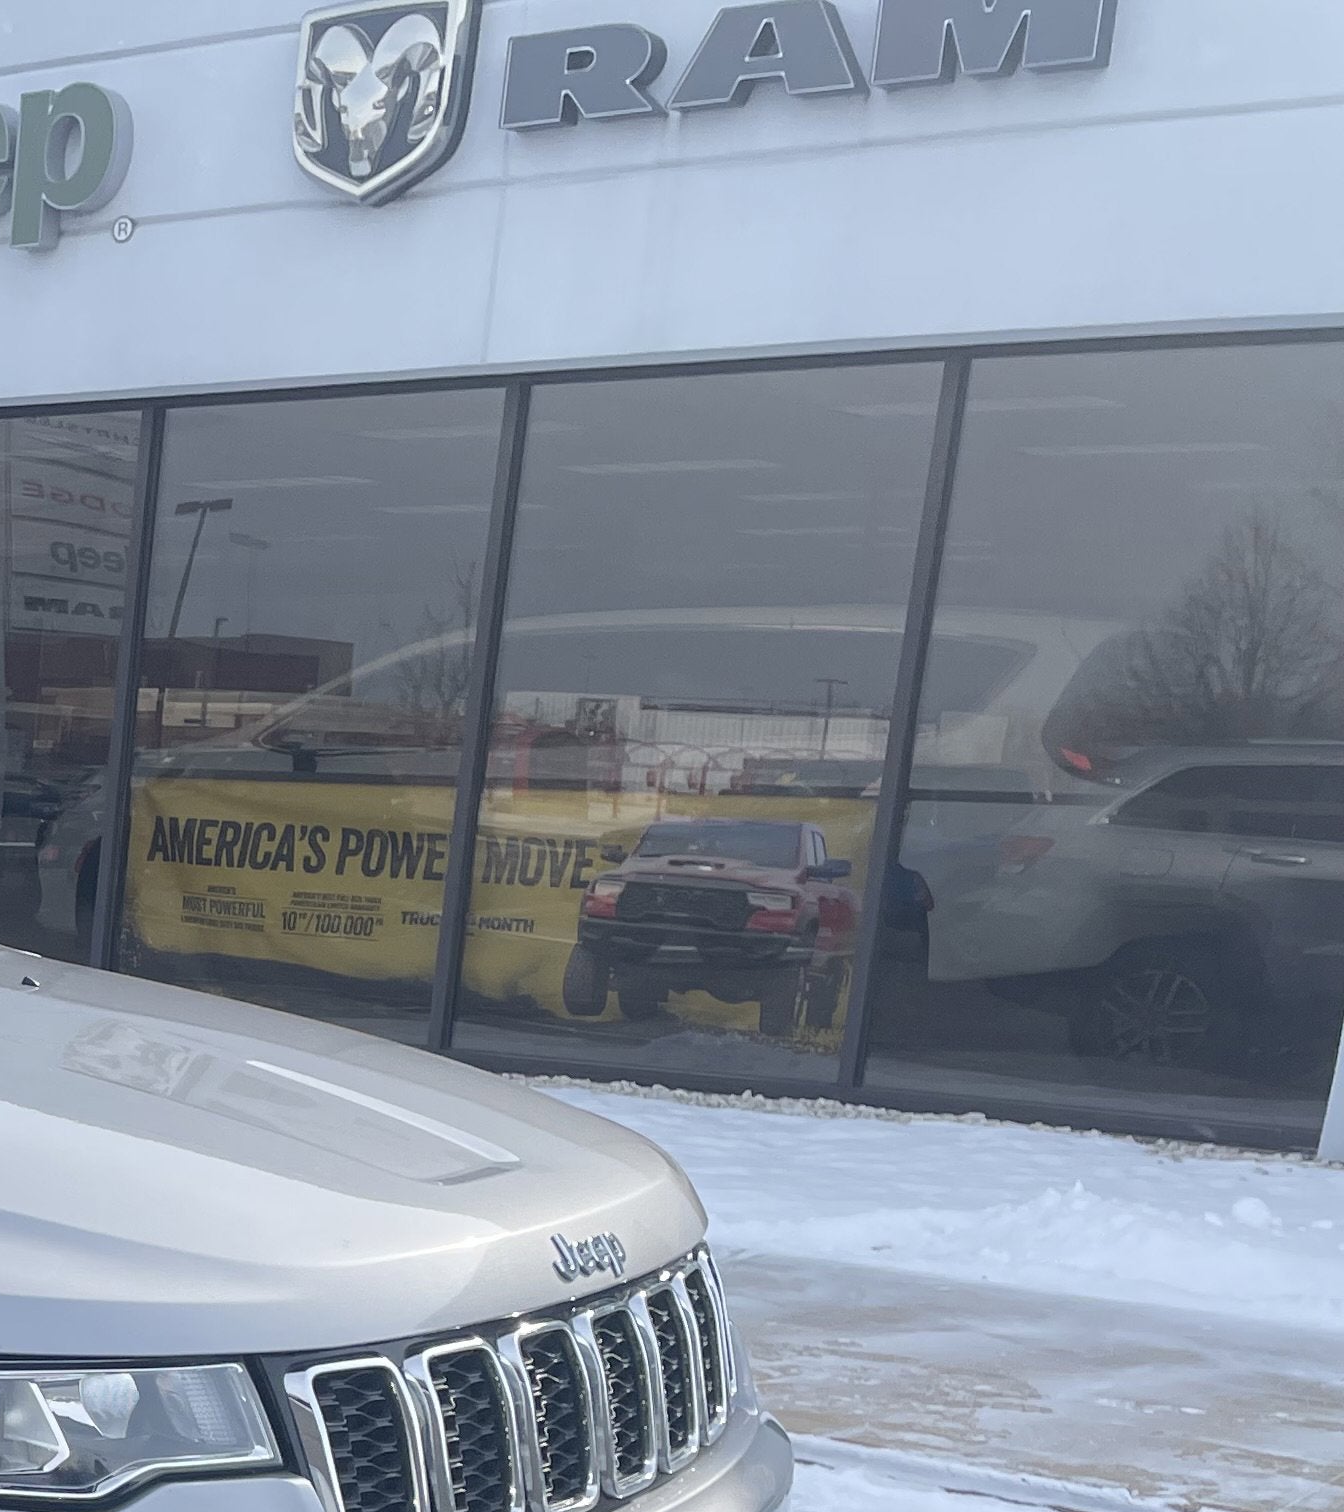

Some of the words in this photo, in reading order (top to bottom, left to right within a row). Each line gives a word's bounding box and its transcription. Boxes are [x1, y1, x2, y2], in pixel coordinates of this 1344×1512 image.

[499, 0, 1116, 131] RAM
[146, 815, 331, 874] AMERICA'S
[334, 827, 452, 881] POWE
[480, 836, 599, 890] MOVE
[209, 899, 266, 919] POWERFUL
[401, 911, 442, 926] TRUC
[478, 917, 535, 933] MONTH
[550, 1232, 626, 1283] Jeep
